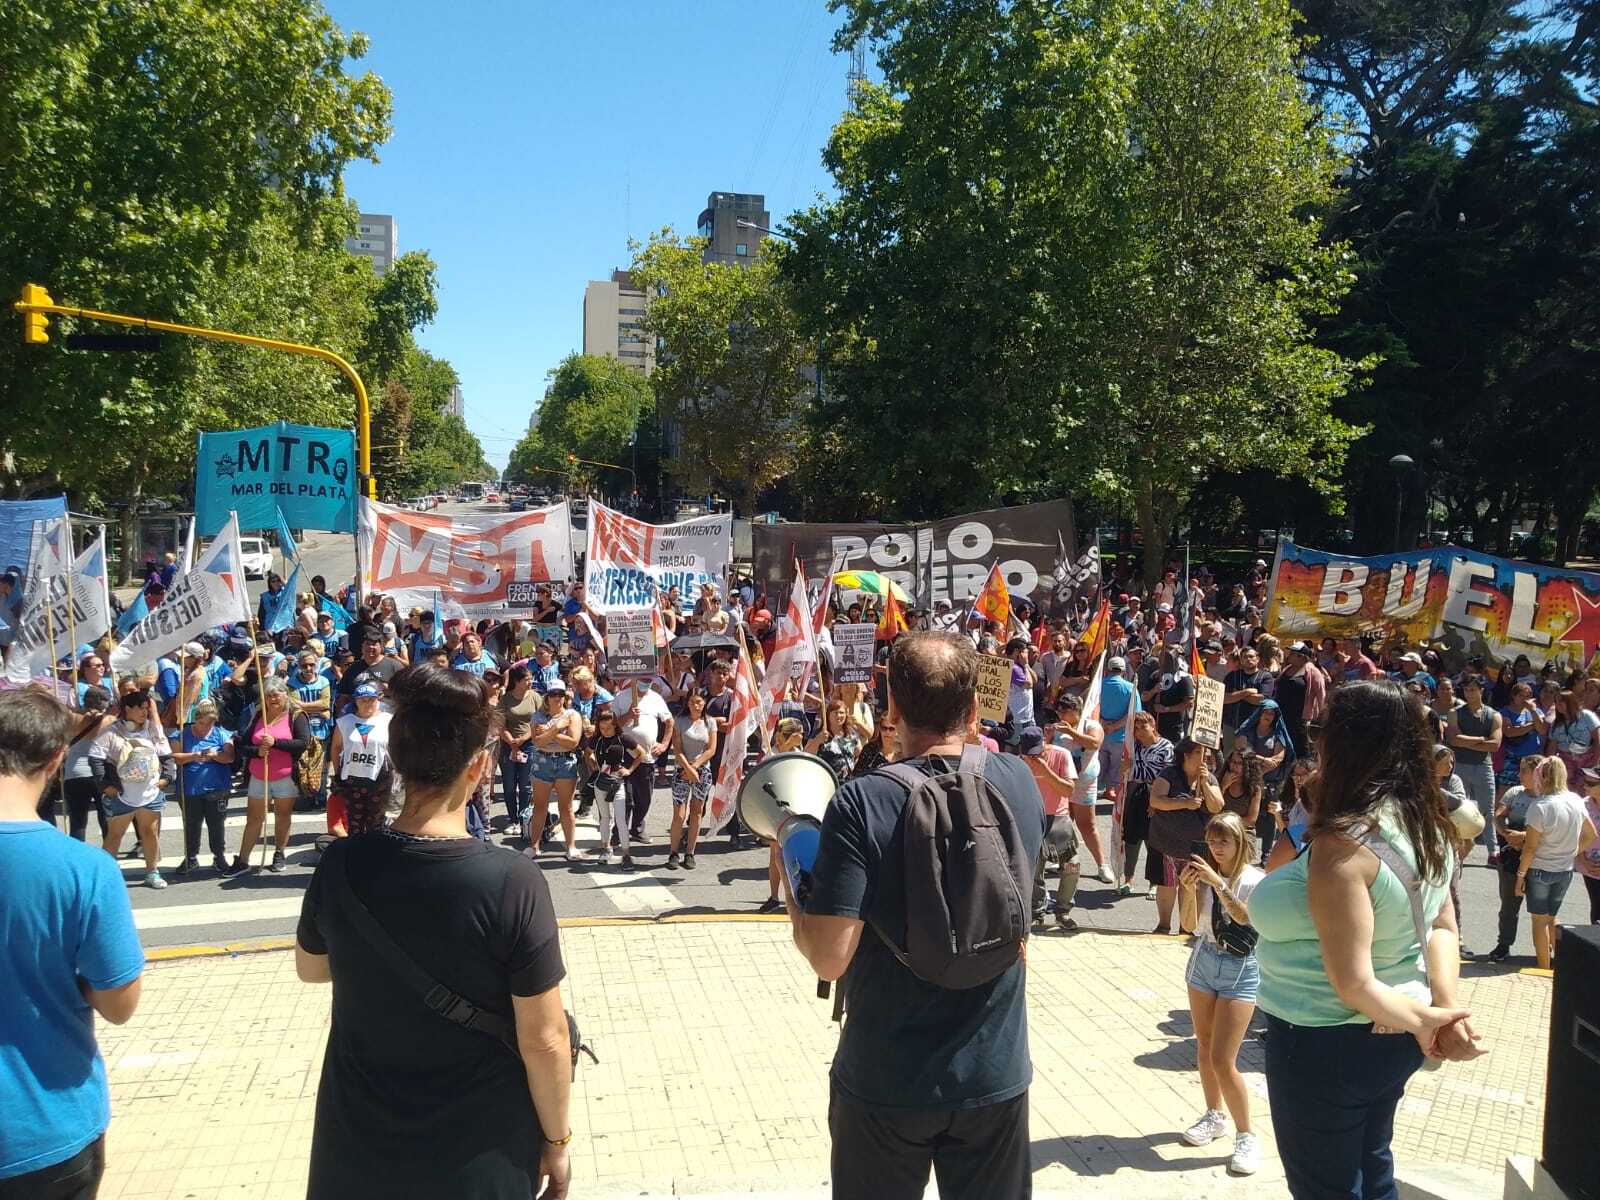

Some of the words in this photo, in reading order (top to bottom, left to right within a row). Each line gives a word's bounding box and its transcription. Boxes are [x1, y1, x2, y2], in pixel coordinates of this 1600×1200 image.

[237, 436, 331, 475] MTR
[231, 482, 263, 496] MAR
[270, 482, 294, 495] DEL
[299, 484, 347, 500] PLATA
[662, 525, 722, 537] MOVIMIENTO
[590, 508, 656, 568] MST
[660, 539, 675, 551] SIN
[832, 521, 993, 572] POLO
[377, 518, 547, 598] MST
[659, 555, 696, 568] TRABAJO
[603, 567, 654, 607] TERESA
[508, 591, 565, 603] IZQUIDA
[1317, 557, 1551, 646] BUEL
[616, 663, 648, 671] OBRERO
[979, 665, 1000, 677] GRAL
[840, 675, 870, 683] OBRERO
[984, 676, 1002, 688] LOS
